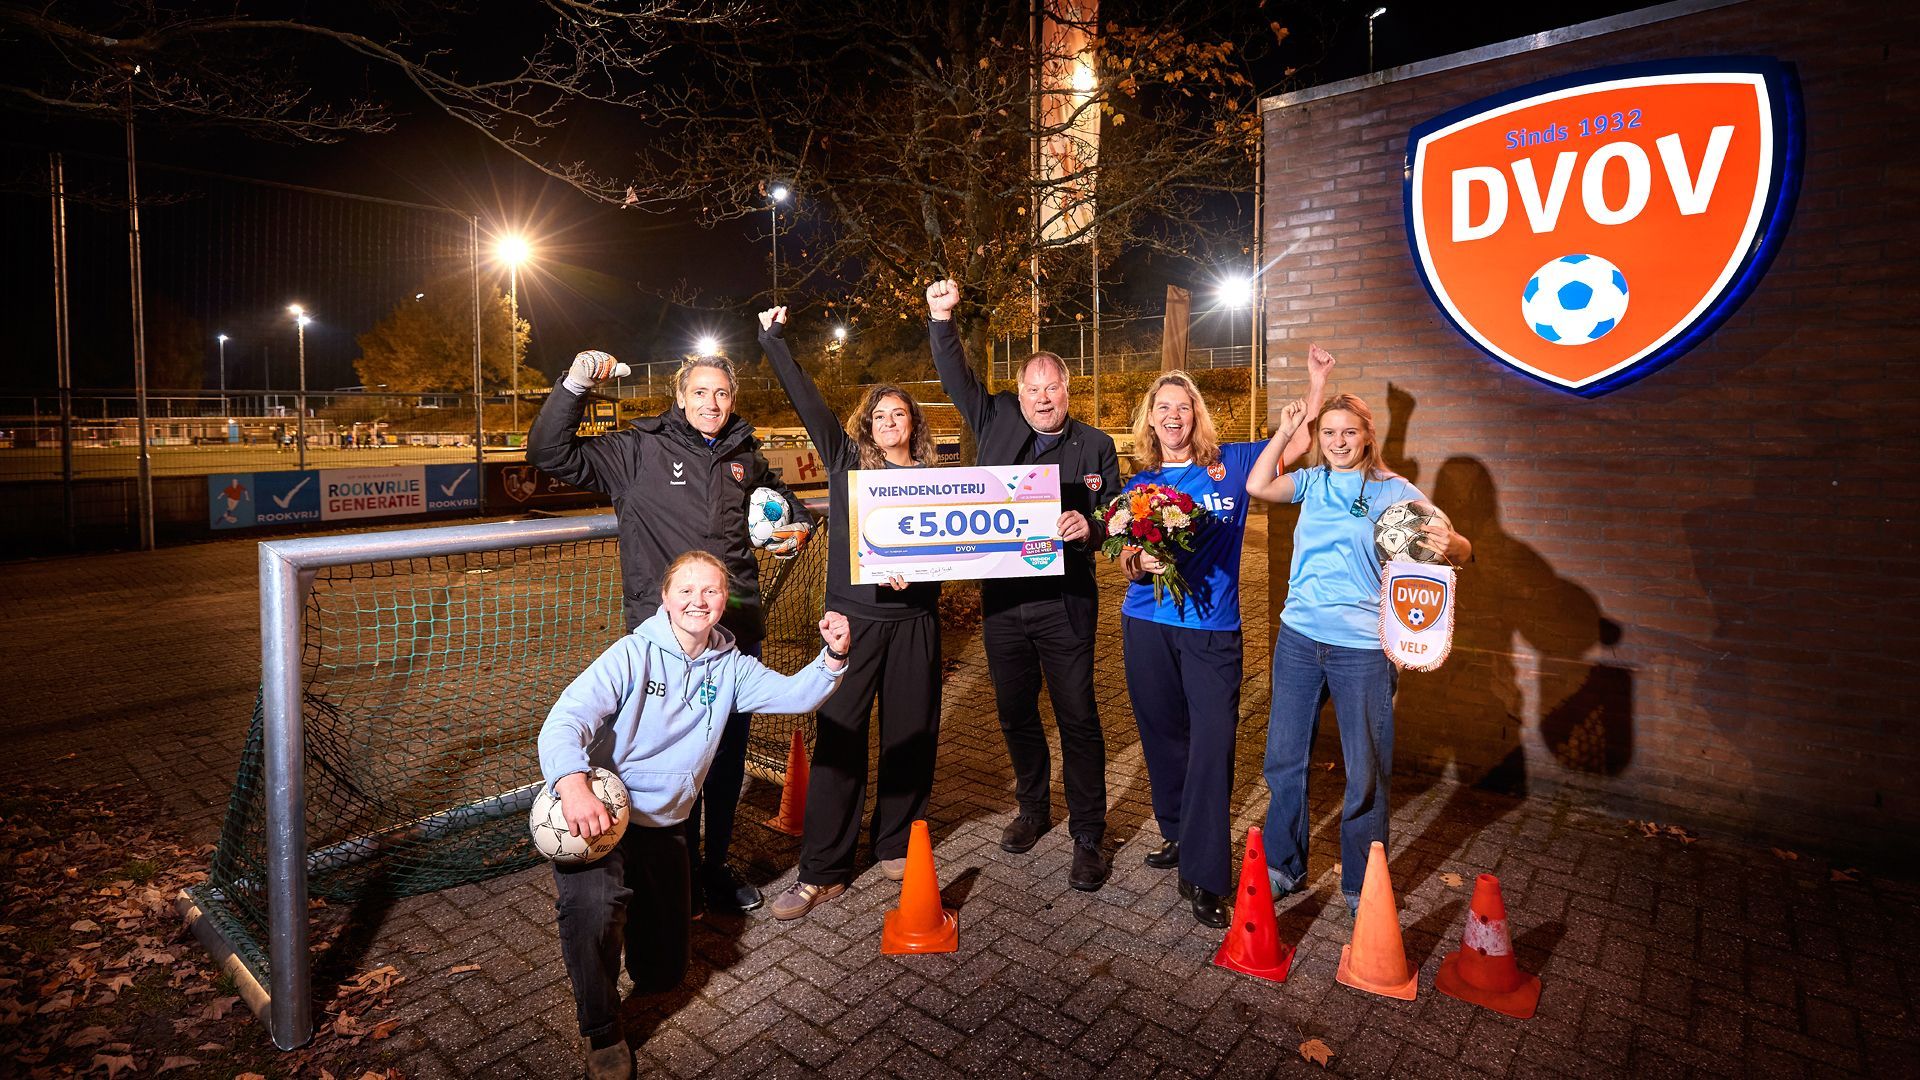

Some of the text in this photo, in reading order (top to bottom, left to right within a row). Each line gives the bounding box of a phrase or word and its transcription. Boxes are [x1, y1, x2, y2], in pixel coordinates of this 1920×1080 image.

[1506, 109, 1643, 150] Sinds 1932
[1452, 125, 1735, 242] DVOV
[329, 480, 419, 497] ROOKVRIJE
[869, 483, 985, 497] VRIENDENLOTERIJ
[329, 495, 420, 512] GENERATIE
[429, 499, 477, 508] ROOKVRIJ
[258, 511, 319, 521] ROOKVRIJ
[1025, 541, 1052, 550] CLUBS
[1397, 587, 1441, 606] DVOV
[1400, 641, 1428, 654] VELP
[645, 681, 666, 697] SB
